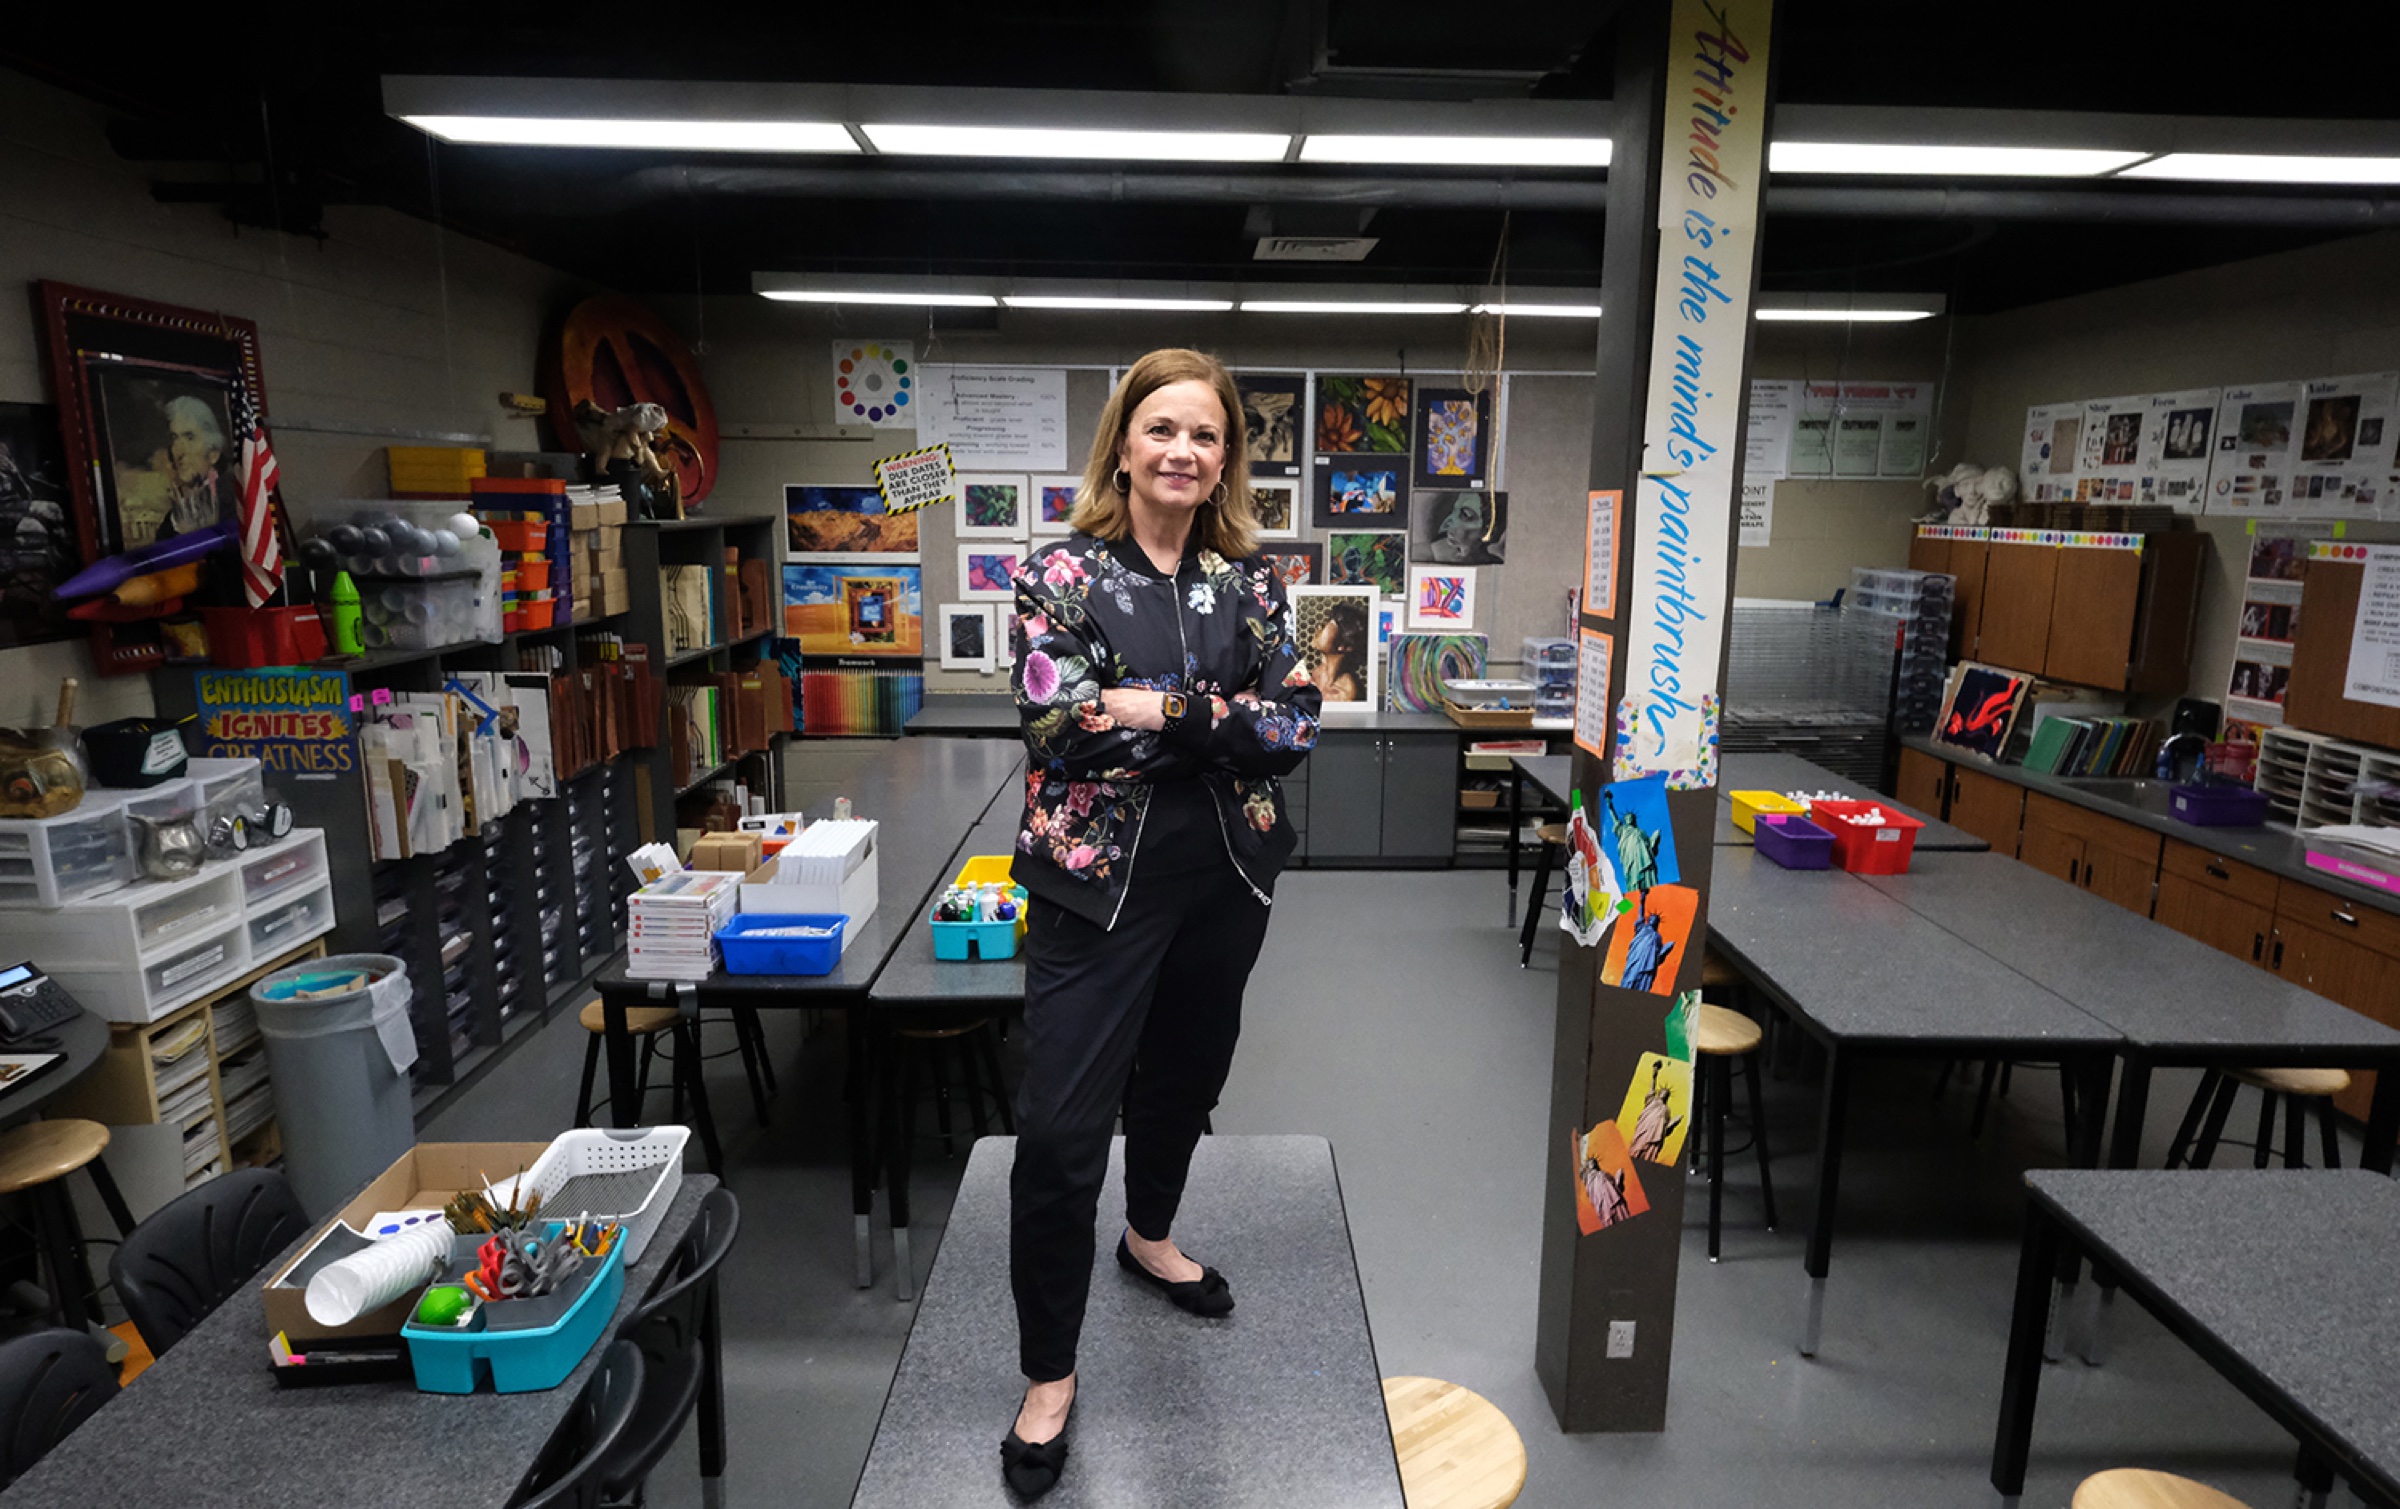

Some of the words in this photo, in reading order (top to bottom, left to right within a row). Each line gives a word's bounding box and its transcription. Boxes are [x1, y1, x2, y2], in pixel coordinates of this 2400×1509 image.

[1687, 2, 1750, 199] Attitude
[1683, 209, 1731, 250] is
[1678, 254, 1732, 323] the
[1008, 375, 1035, 384] Grading
[2309, 382, 2339, 394] Value
[1667, 334, 1718, 468] mind's
[2152, 397, 2176, 408] Form
[888, 470, 908, 480] DUE
[911, 461, 942, 475] DATES
[888, 478, 907, 490] ARE
[910, 469, 947, 484] CLOSER
[892, 485, 921, 498] THAN
[922, 478, 948, 490] THEY
[904, 489, 942, 504] APPEAR
[1645, 473, 1706, 757] paintbrush
[201, 674, 342, 707] ENTHUSIASM
[221, 712, 333, 738] IGNITES
